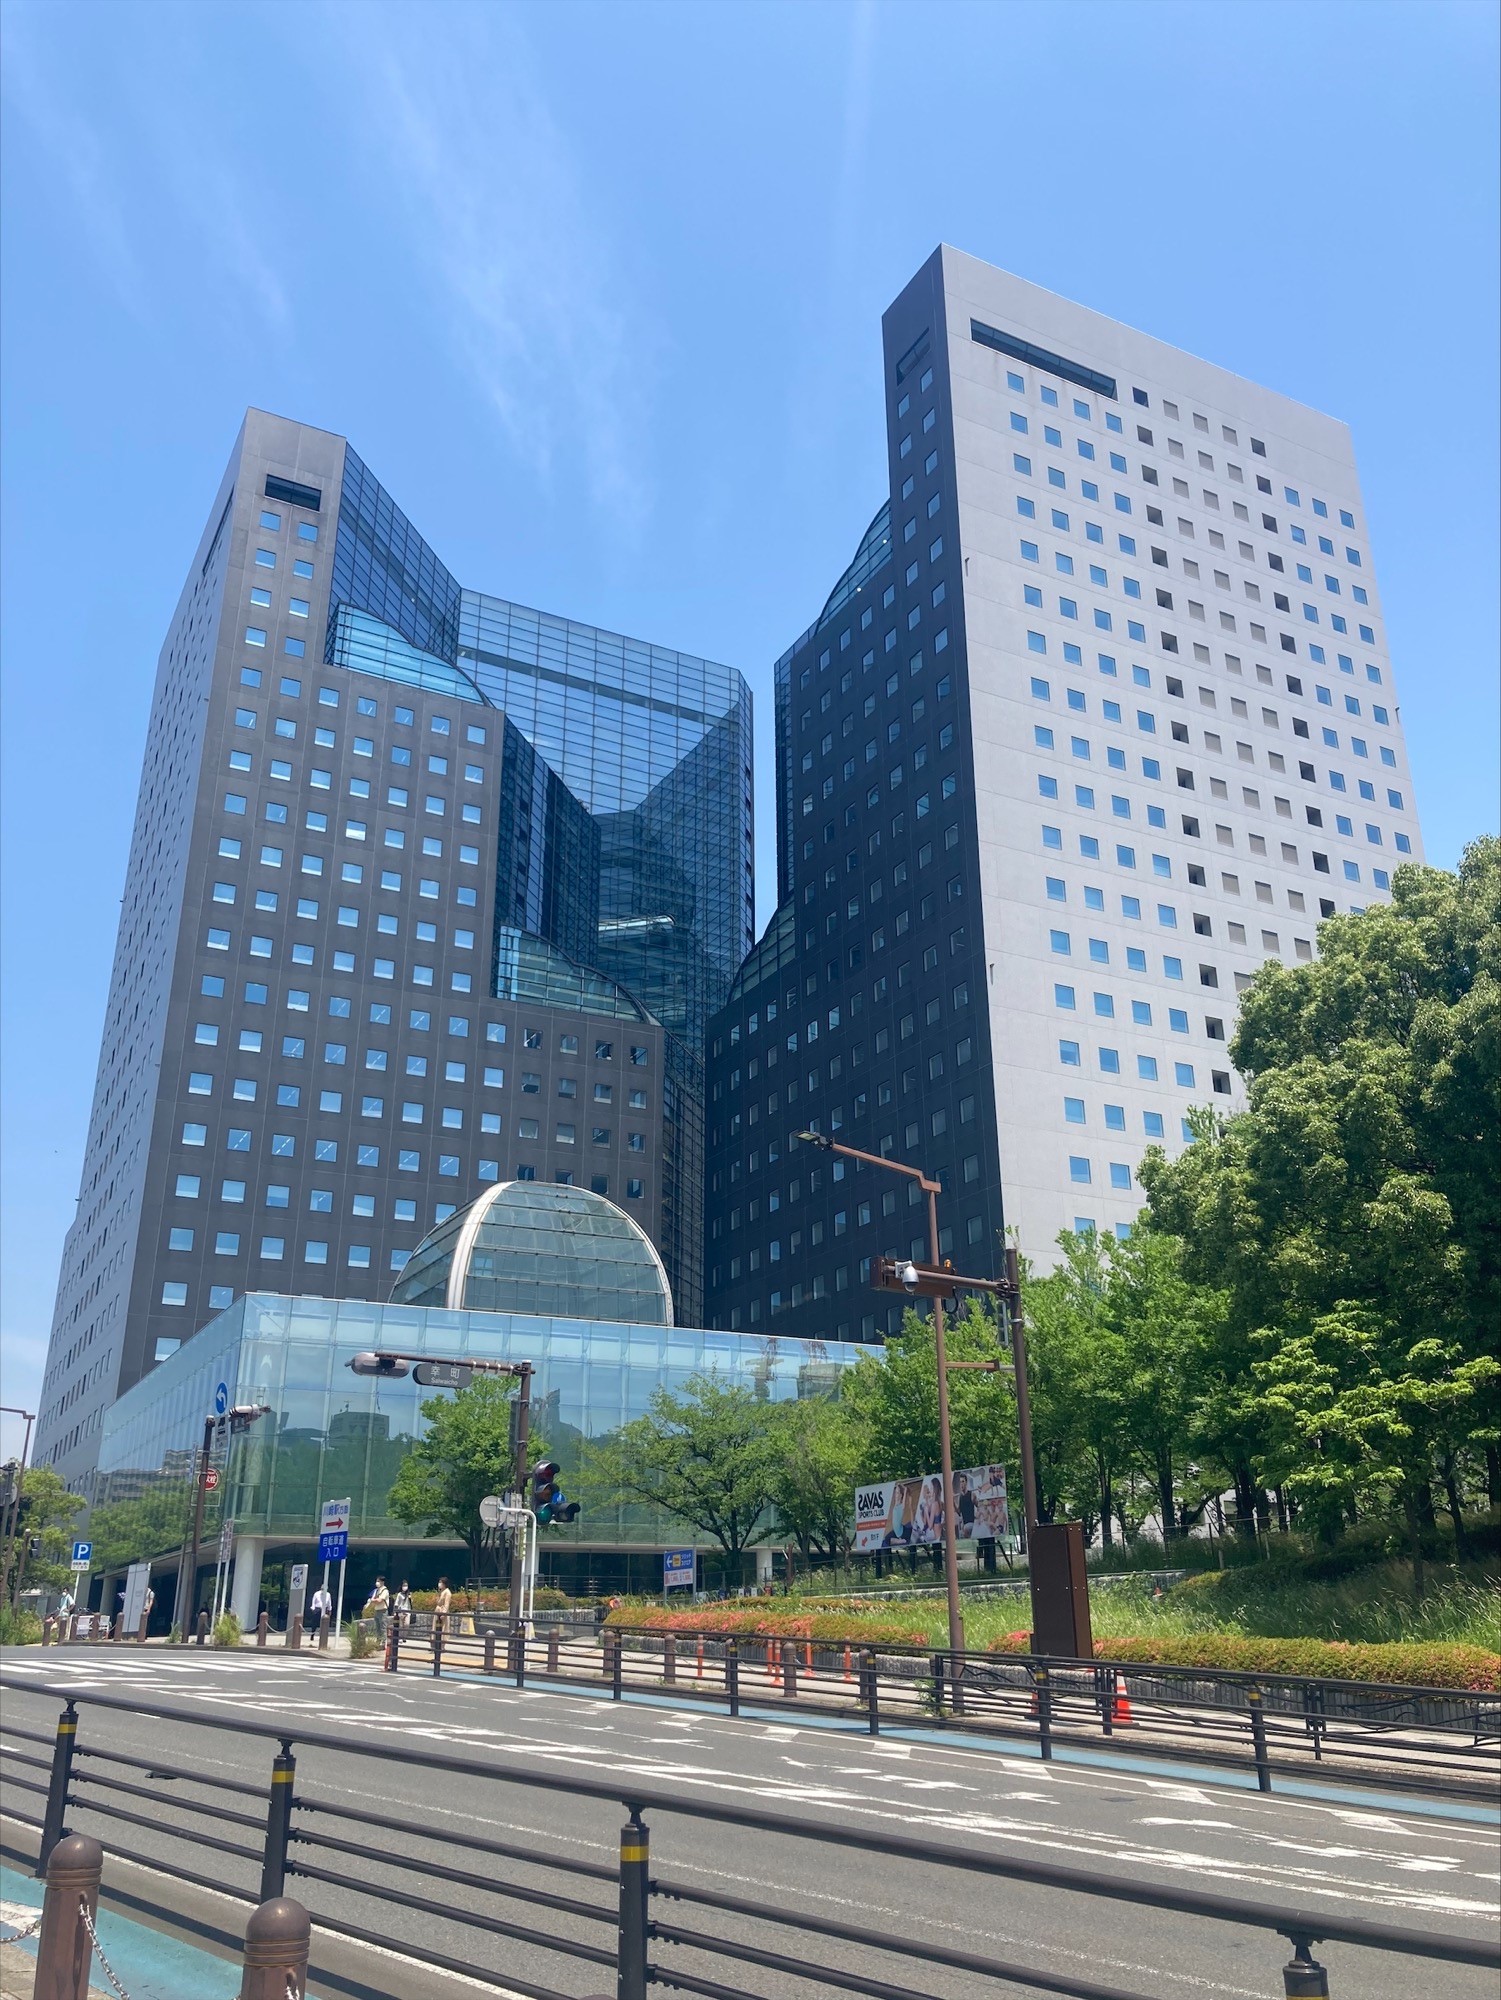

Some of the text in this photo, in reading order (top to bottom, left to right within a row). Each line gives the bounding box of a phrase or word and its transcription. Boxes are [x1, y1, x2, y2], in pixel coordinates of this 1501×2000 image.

[858, 1491, 884, 1511] SAVAS
[858, 1509, 884, 1519] SPORTS CLUB
[77, 1544, 89, 1558] P
[326, 1547, 340, 1558] 入口
